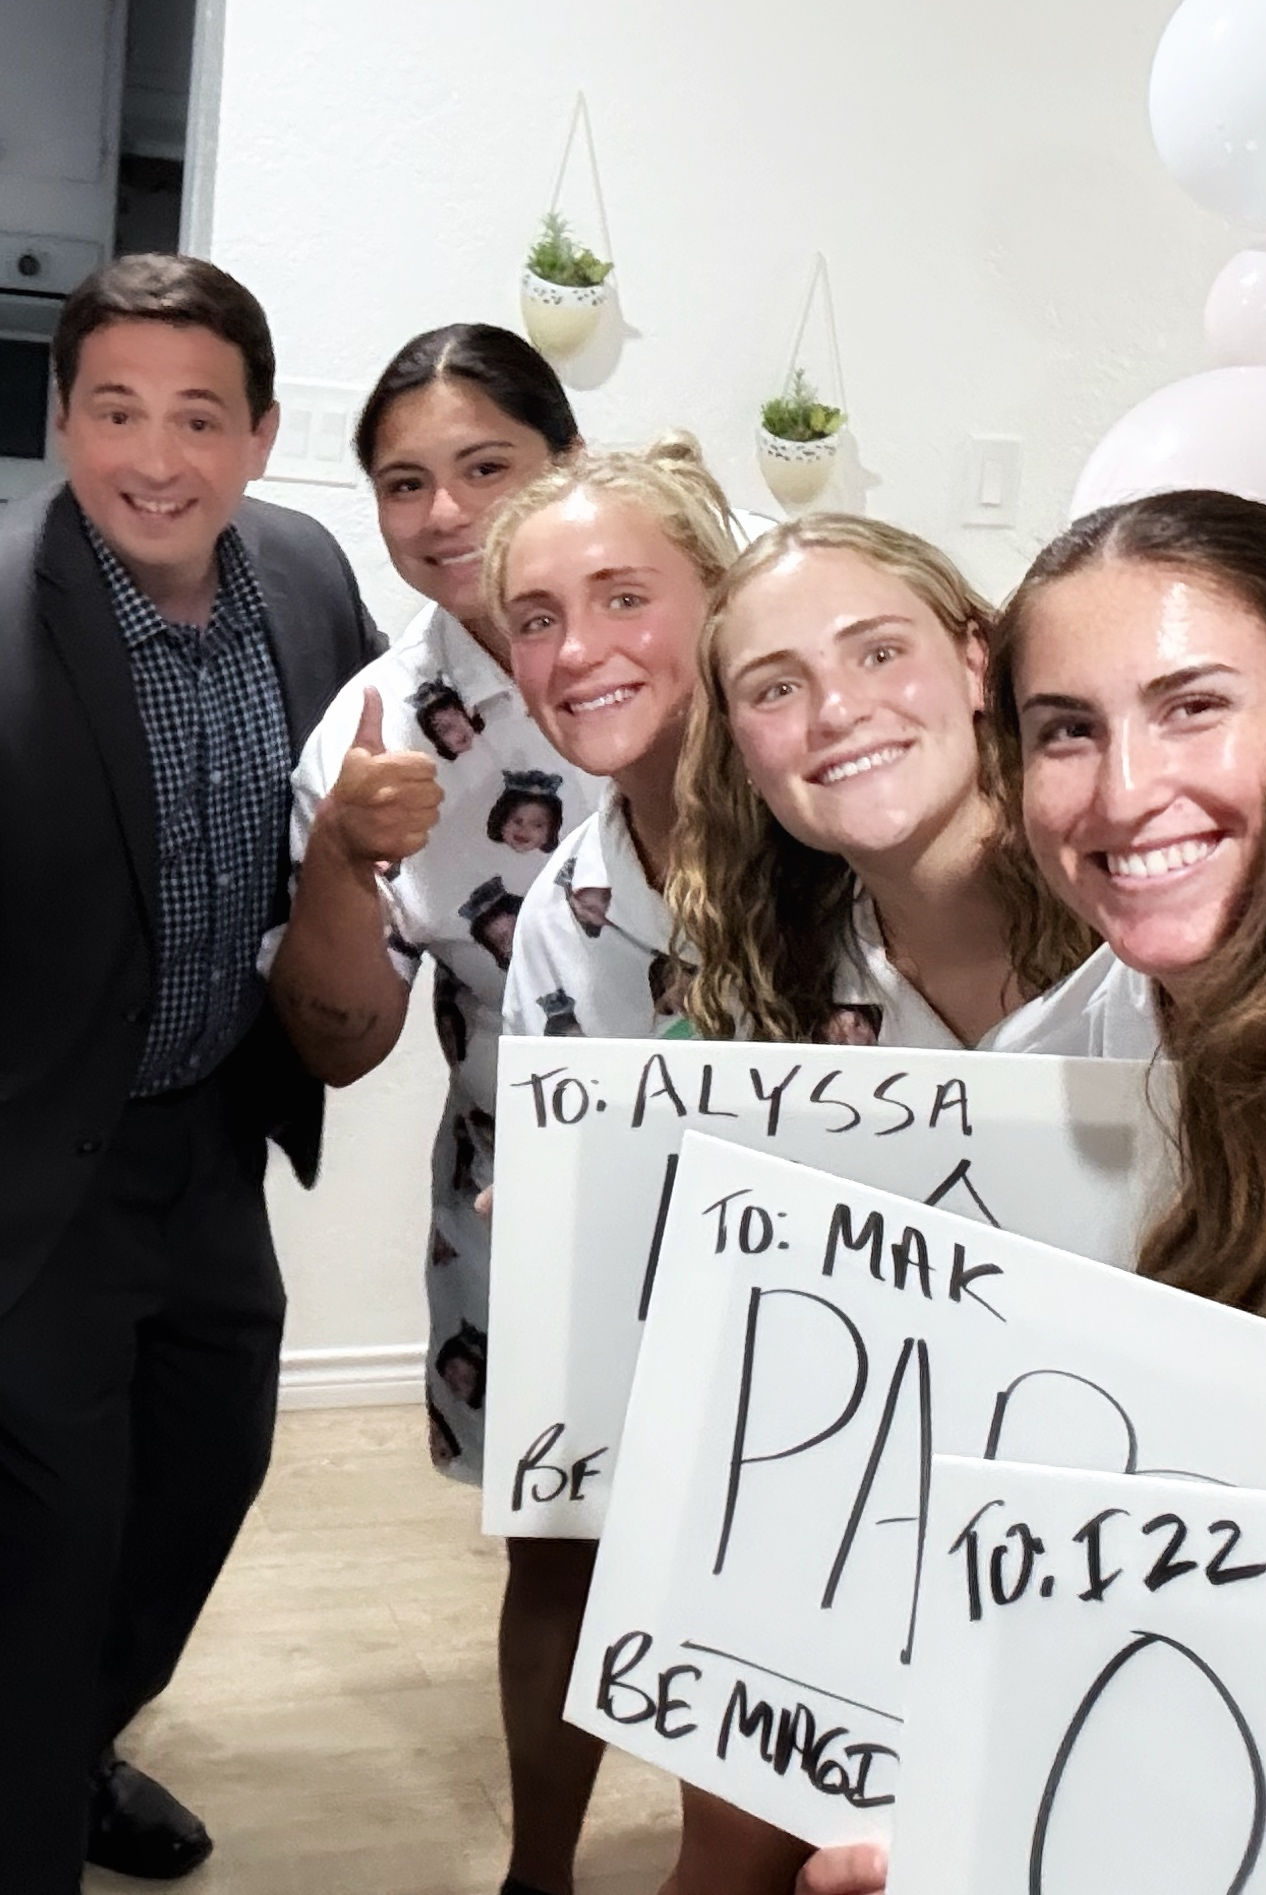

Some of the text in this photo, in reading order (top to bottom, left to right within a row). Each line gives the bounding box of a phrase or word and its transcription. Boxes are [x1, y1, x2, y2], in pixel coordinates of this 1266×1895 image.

[510, 1053, 973, 1136] TO: ALYSSA
[701, 1188, 790, 1254] TO:
[821, 1202, 1007, 1323] MAK
[511, 1422, 609, 1512] BE
[596, 1630, 703, 1740] BE
